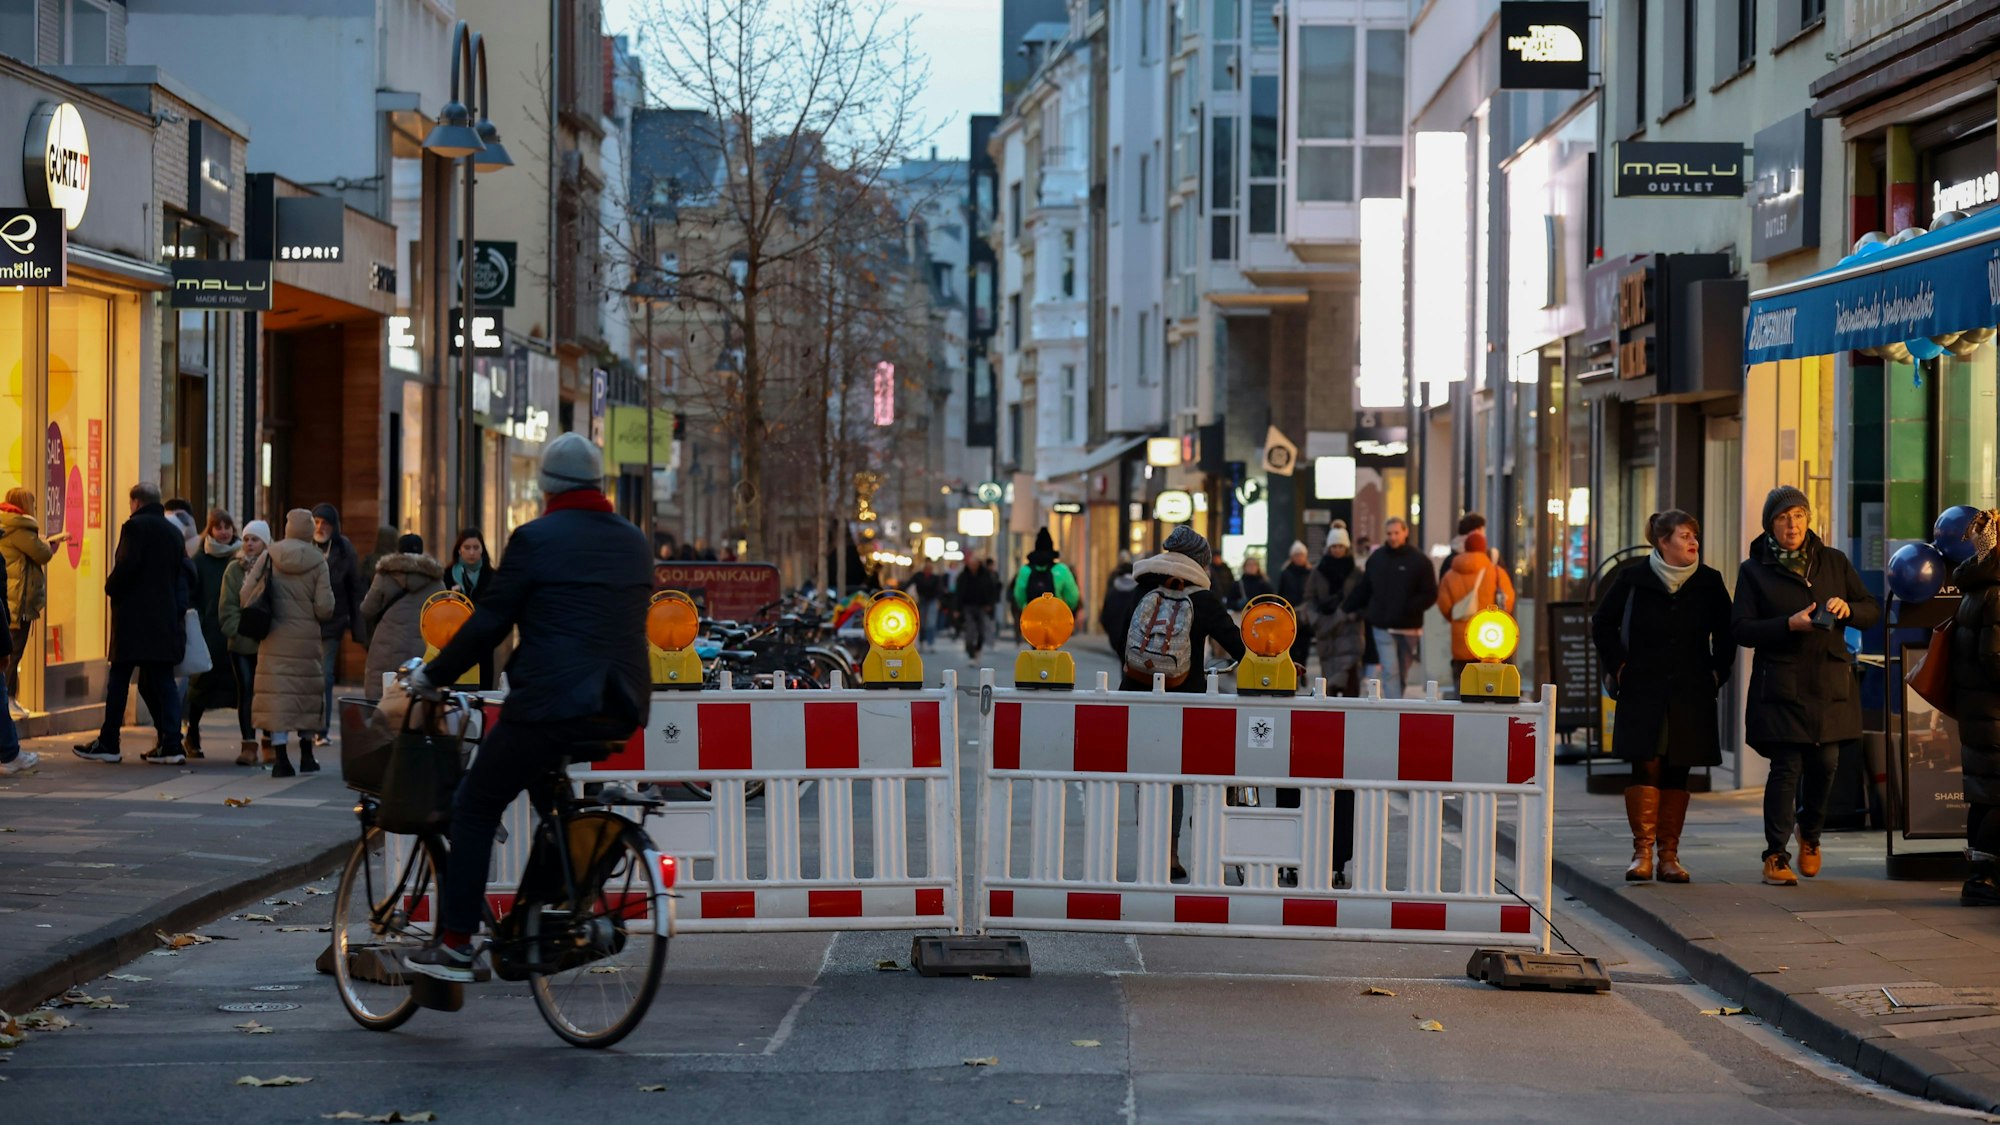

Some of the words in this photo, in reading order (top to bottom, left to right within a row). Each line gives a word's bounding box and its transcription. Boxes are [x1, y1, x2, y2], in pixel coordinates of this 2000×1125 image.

[79, 153, 89, 190] 17
[1623, 163, 1738, 176] MALU
[1648, 182, 1714, 192] OUTLET
[1765, 214, 1788, 239] OUTLET
[176, 279, 266, 291] MALU
[195, 295, 217, 303] MADE
[218, 295, 227, 303] IN
[228, 295, 248, 303] ITALY
[595, 376, 604, 410] P
[47, 438, 61, 465] SALE
[659, 569, 771, 582] GOLDANKAUF
